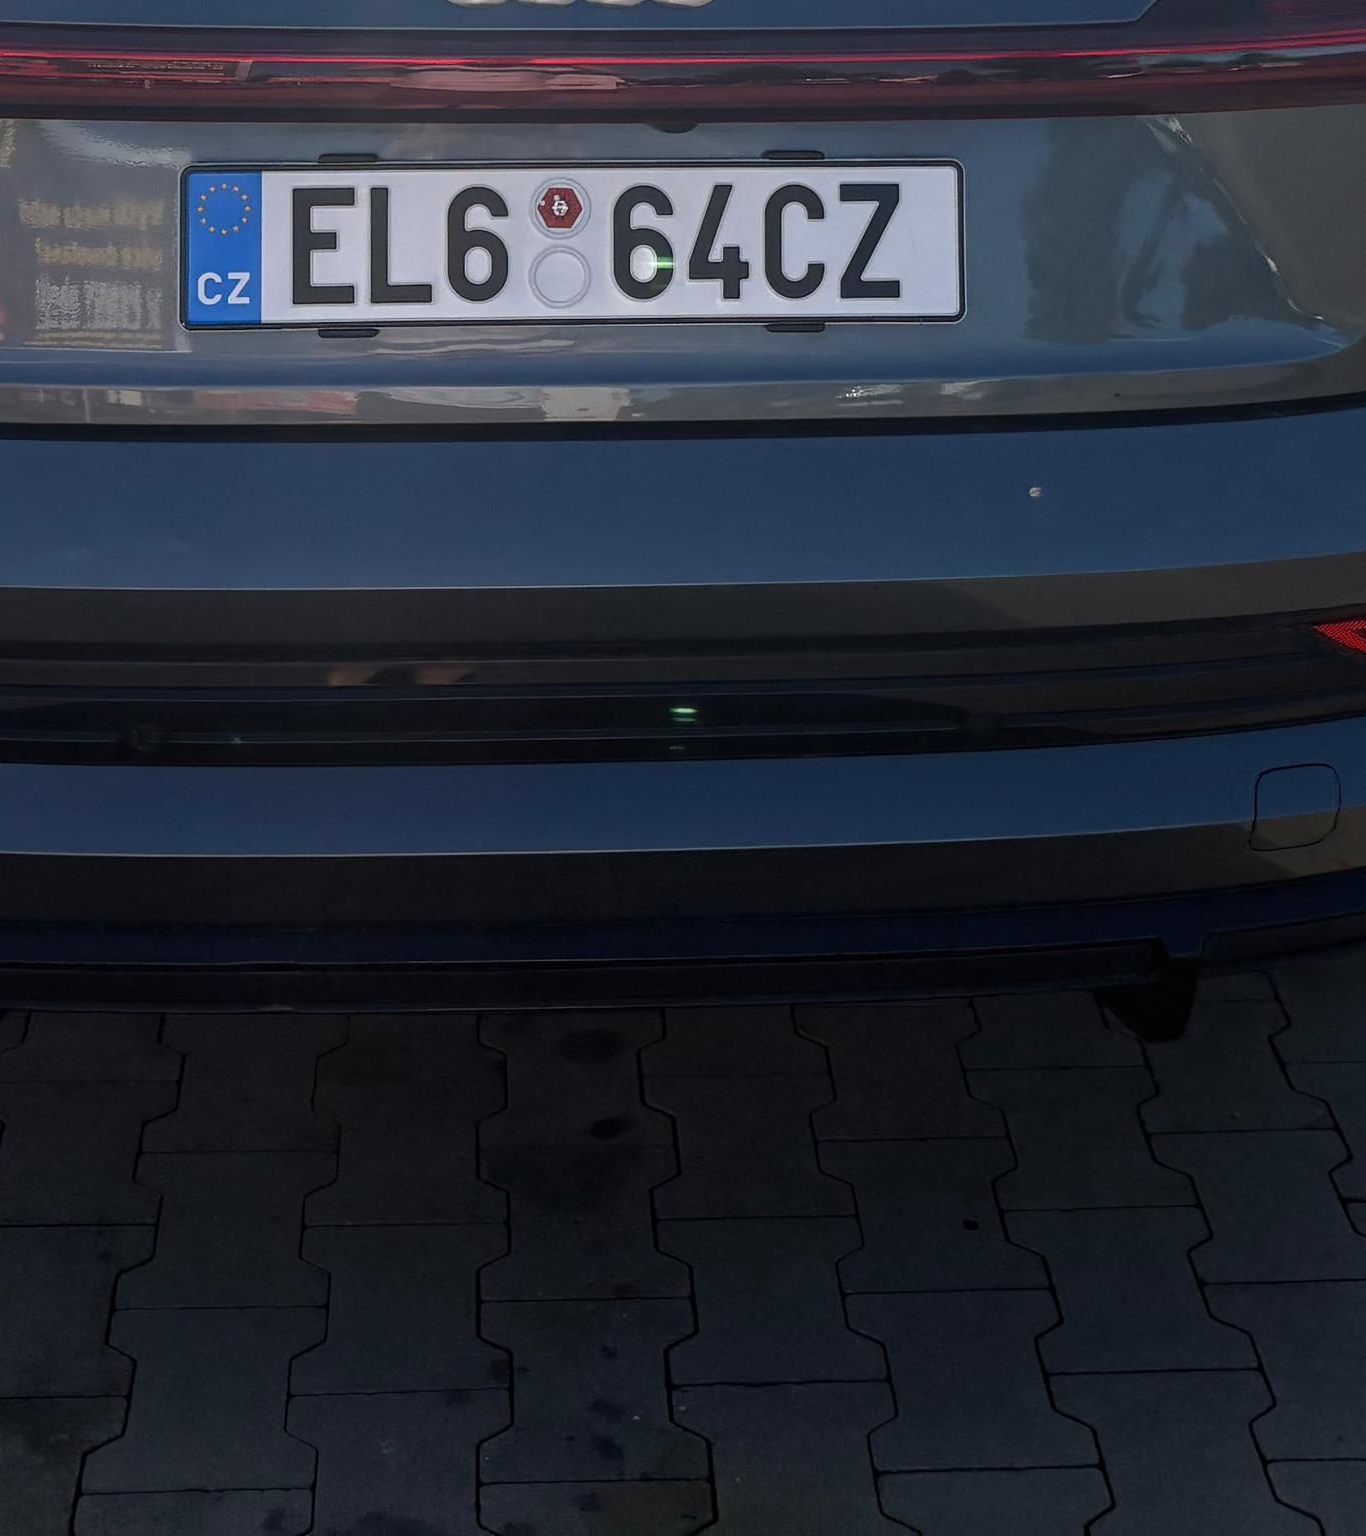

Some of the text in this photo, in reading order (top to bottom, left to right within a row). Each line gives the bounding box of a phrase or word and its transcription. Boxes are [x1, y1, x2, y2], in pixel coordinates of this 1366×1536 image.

[291, 182, 902, 305] EL6 64CZ
[197, 271, 251, 306] CZ
